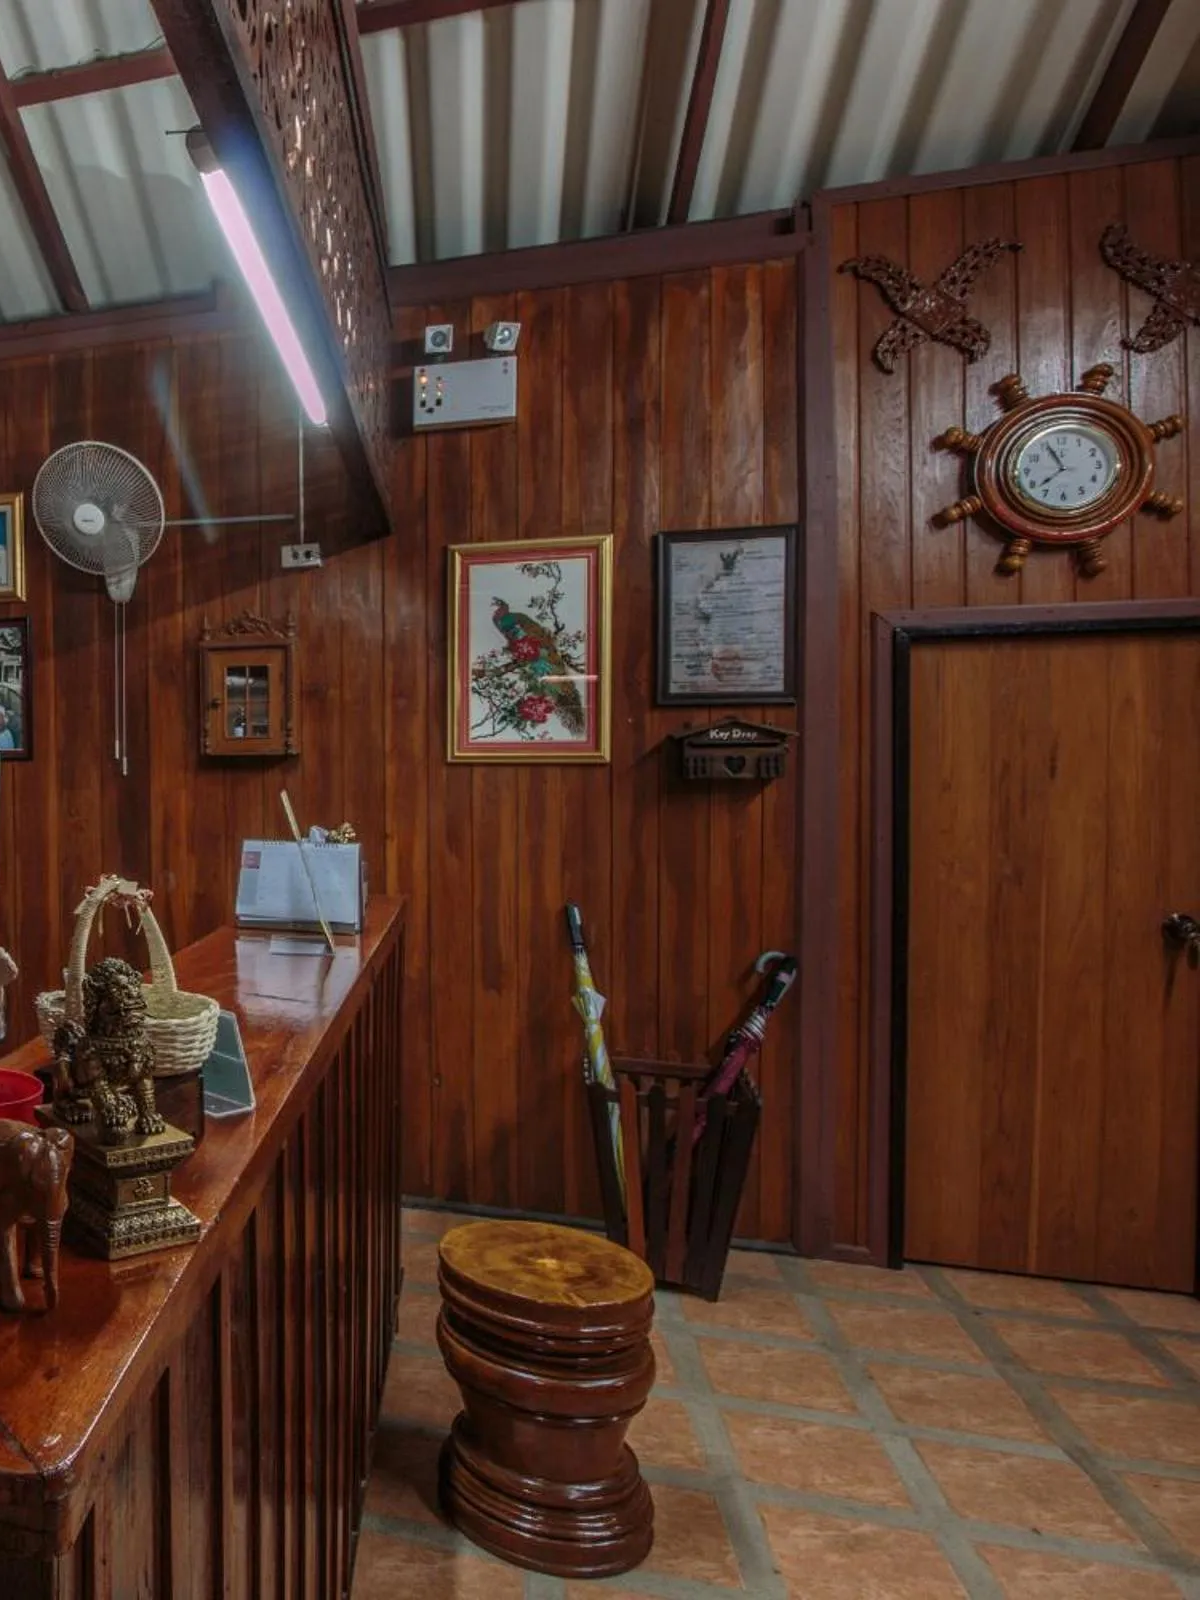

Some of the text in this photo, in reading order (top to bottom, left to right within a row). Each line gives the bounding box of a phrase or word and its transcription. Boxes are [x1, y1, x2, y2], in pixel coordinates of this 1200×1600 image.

[1088, 448, 1097, 457] 2
[1095, 460, 1102, 470] 3
[1041, 489, 1049, 498] 7
[1078, 486, 1085, 495] 5
[1060, 491, 1066, 502] 6
[709, 728, 730, 740] Key
